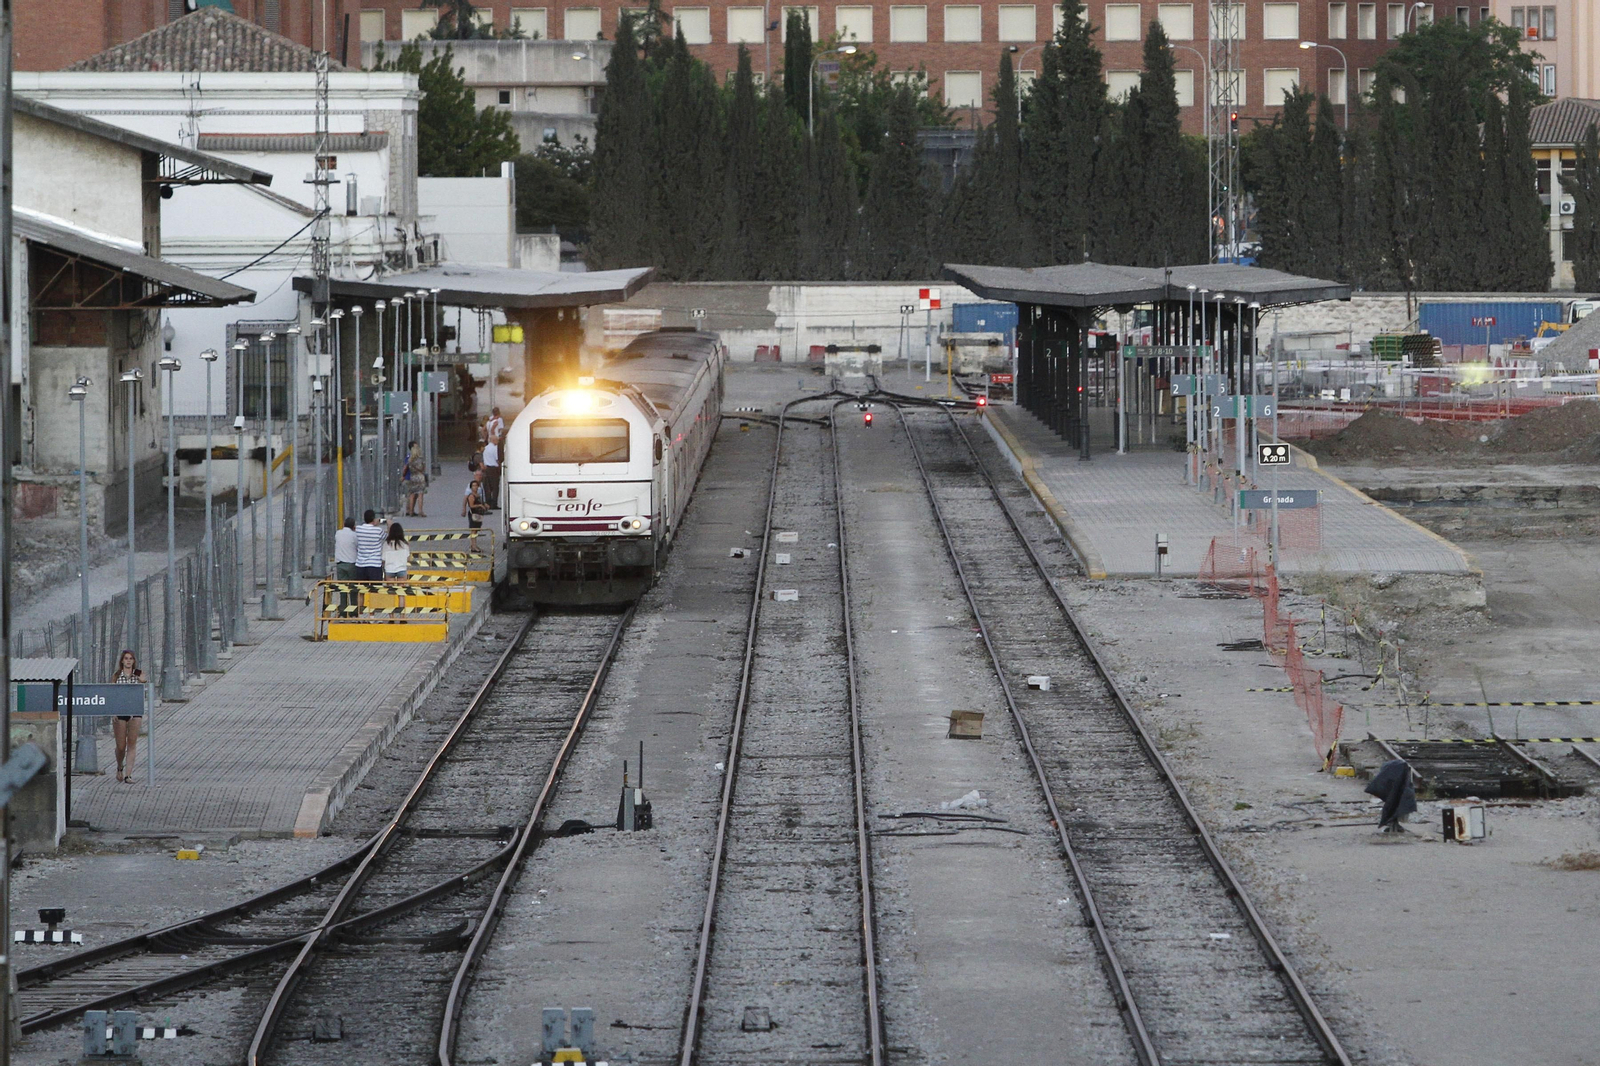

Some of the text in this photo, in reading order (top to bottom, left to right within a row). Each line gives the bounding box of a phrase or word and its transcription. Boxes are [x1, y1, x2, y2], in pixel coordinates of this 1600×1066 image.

[439, 381, 446, 392] 3
[1173, 384, 1179, 394] 2
[402, 402, 409, 413] 3
[1213, 405, 1220, 417] 2
[1264, 405, 1271, 415] 6
[556, 497, 603, 517] renfe
